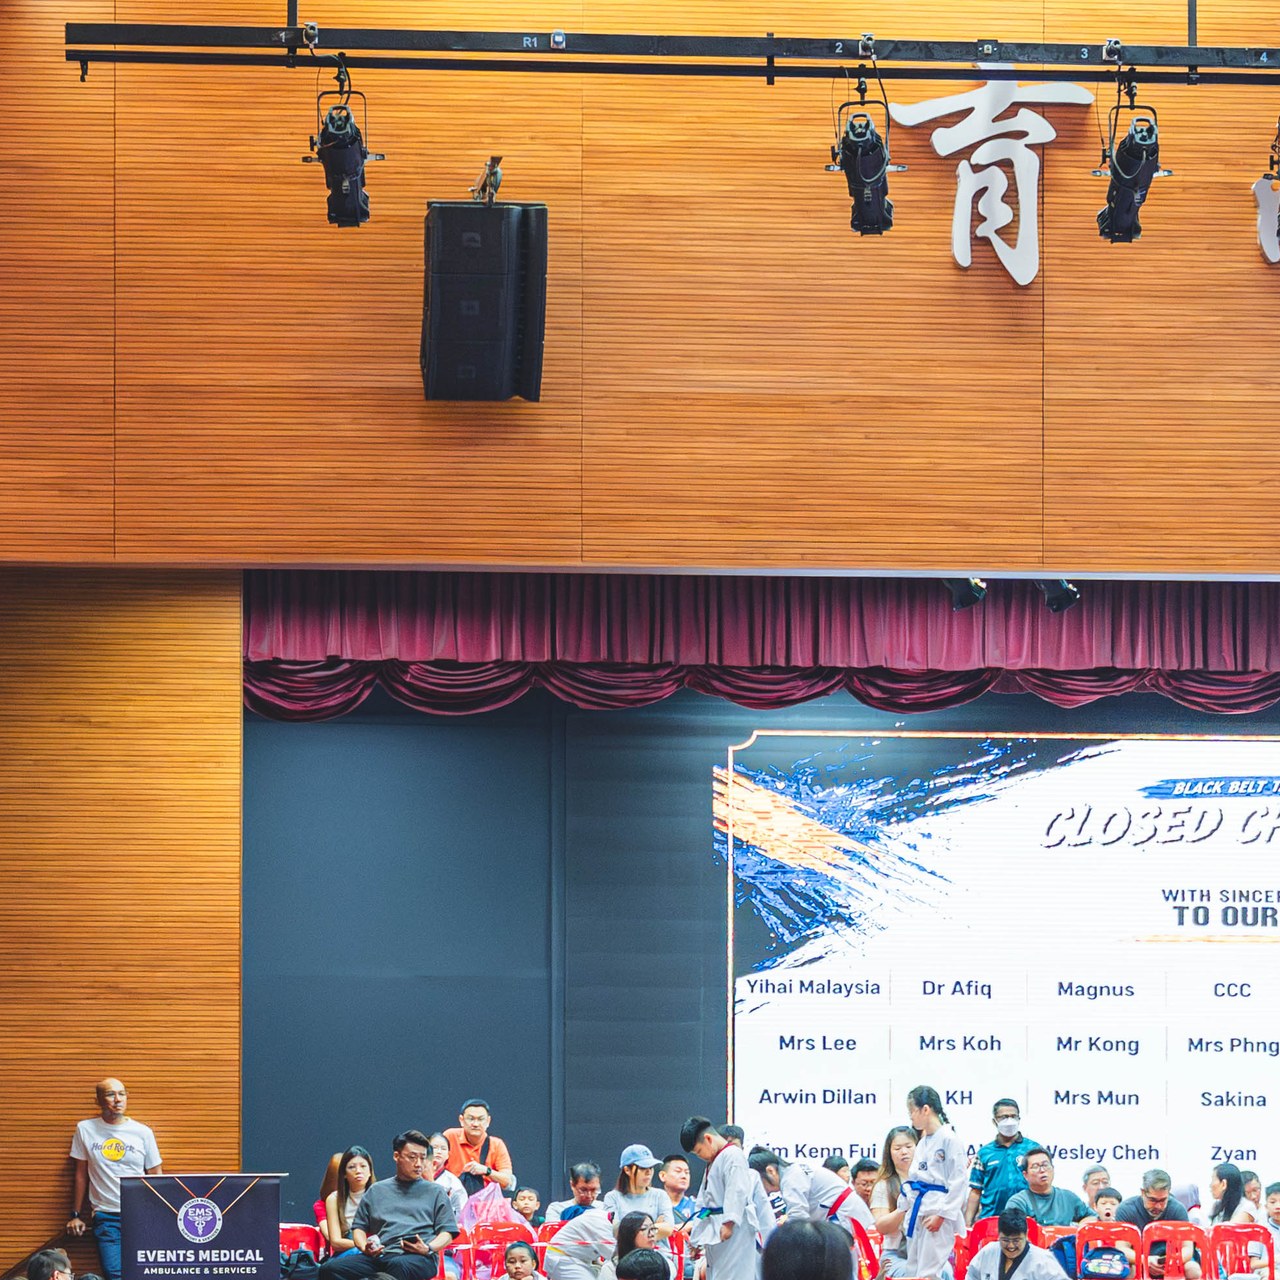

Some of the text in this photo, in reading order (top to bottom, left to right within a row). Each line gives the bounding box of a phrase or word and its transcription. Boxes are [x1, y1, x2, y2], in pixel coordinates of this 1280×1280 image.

[522, 36, 539, 49] R1
[834, 42, 843, 54] 2
[1079, 47, 1089, 60] 3
[1259, 51, 1269, 63] 4
[1173, 780, 1224, 796] BLACK
[1228, 779, 1269, 795] BELT
[1041, 802, 1224, 849] CLOSED
[1162, 888, 1212, 903] WITH
[1173, 906, 1210, 927] TO
[1221, 906, 1279, 928] OUR
[746, 979, 881, 998] Yihai Malaysia
[922, 980, 992, 999] Dr Afiq
[1057, 981, 1135, 1000] Magnus
[1213, 983, 1252, 998] CCC
[779, 1035, 857, 1051] Mrs Lee
[919, 1035, 1002, 1052] Mrs Koh
[1056, 1036, 1140, 1056] Mr Kong
[1187, 1037, 1280, 1057] Mrs Phng
[759, 1088, 877, 1104] Arwin Dillan
[945, 1090, 973, 1105] KH
[1054, 1090, 1139, 1106] Mrs Mun
[1201, 1091, 1267, 1107] Sakina
[91, 1142, 135, 1153] Hard Rock
[795, 1144, 877, 1159] Kenn Fui
[1112, 1144, 1159, 1160] Cheh
[1211, 1145, 1257, 1163] Zyan
[188, 1208, 213, 1216] EMS
[137, 1249, 264, 1262] EVENTS MEDICAL
[144, 1266, 257, 1275] AMBULANCE & SERVICES
